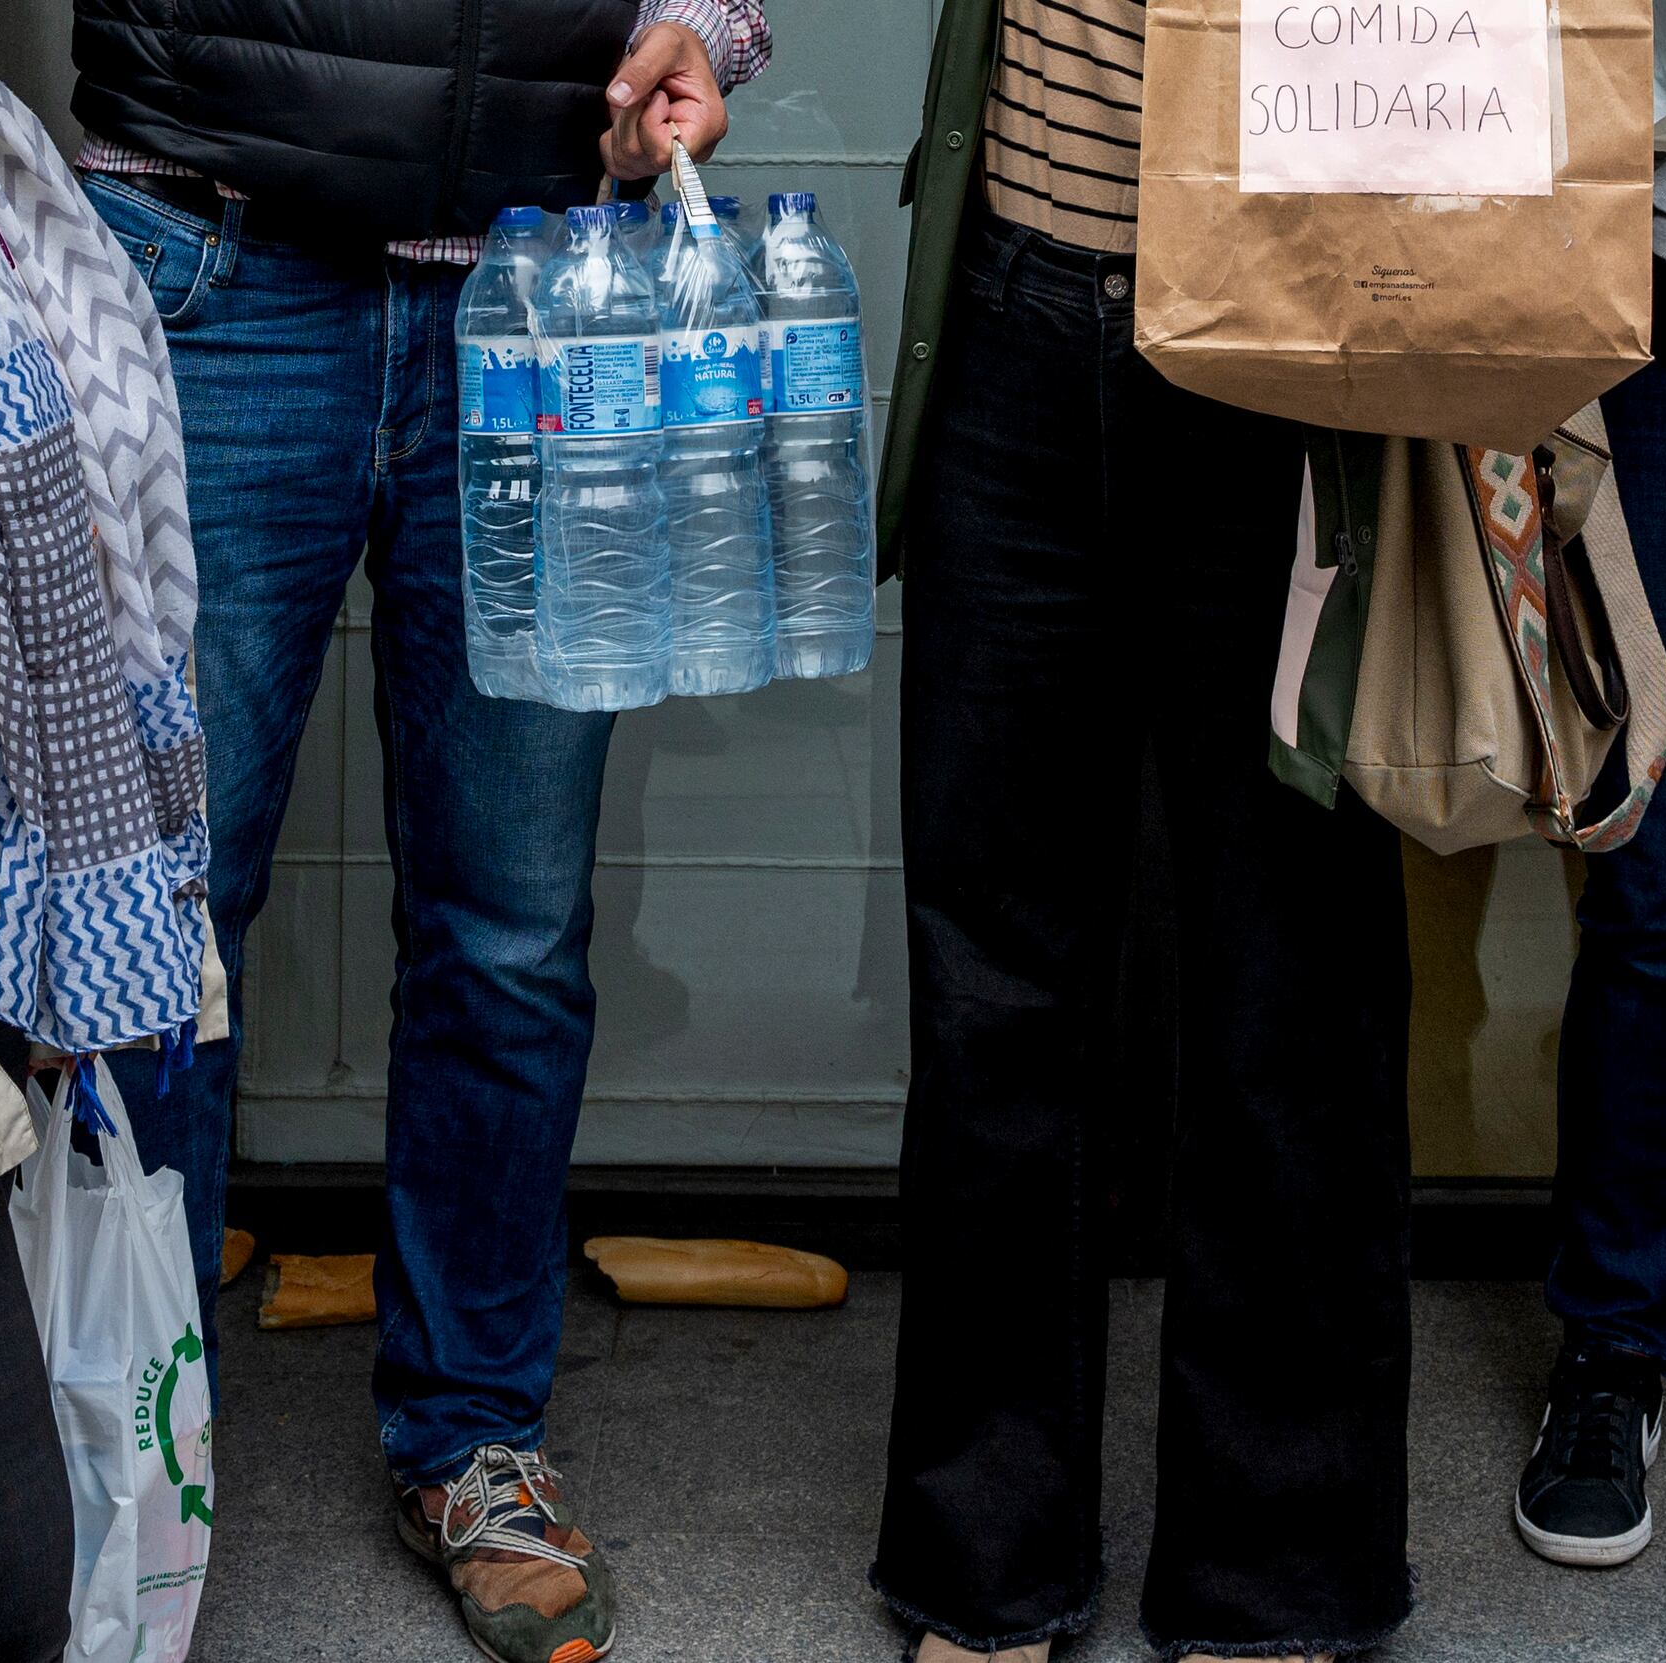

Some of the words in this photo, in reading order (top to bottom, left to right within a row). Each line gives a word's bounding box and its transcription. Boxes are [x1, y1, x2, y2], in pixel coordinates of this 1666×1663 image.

[1274, 3, 1480, 49] COMIDA
[1249, 80, 1512, 135] SOLIDARIA
[1369, 281, 1435, 290] empanadasmorfi
[568, 345, 595, 430] FONTECELTA
[694, 370, 736, 382] NATURAL
[789, 394, 814, 406] 1,5L
[492, 417, 514, 431] 1,5L
[135, 1357, 164, 1451] REDUCE
